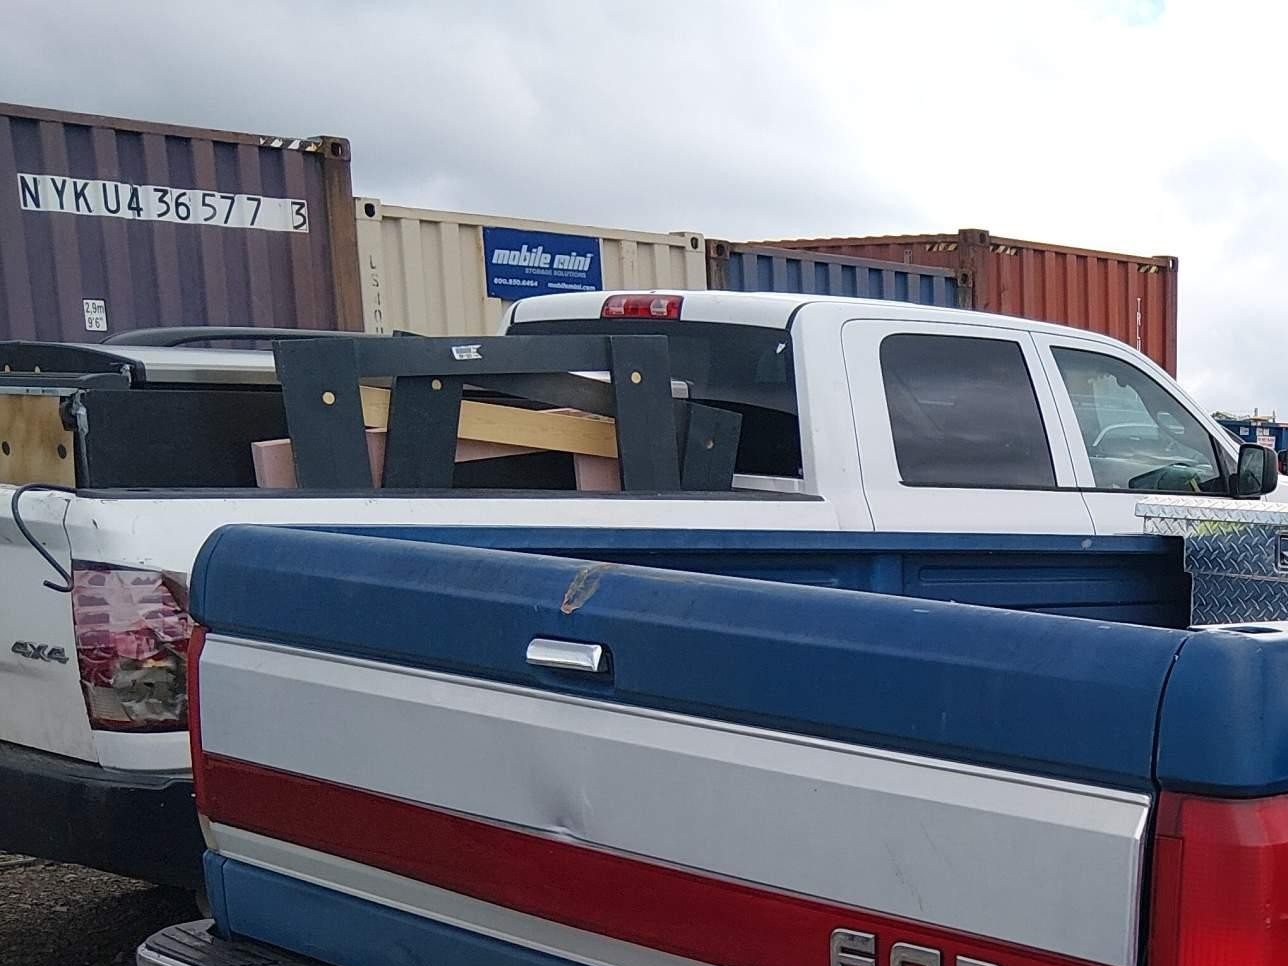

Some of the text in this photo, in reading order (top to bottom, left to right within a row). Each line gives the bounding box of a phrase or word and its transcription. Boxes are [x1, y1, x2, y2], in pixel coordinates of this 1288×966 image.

[292, 201, 307, 231] 3
[492, 245, 592, 271] mobile mini
[553, 270, 587, 278] SOLUTIONS
[547, 282, 596, 291] mobilemini.com
